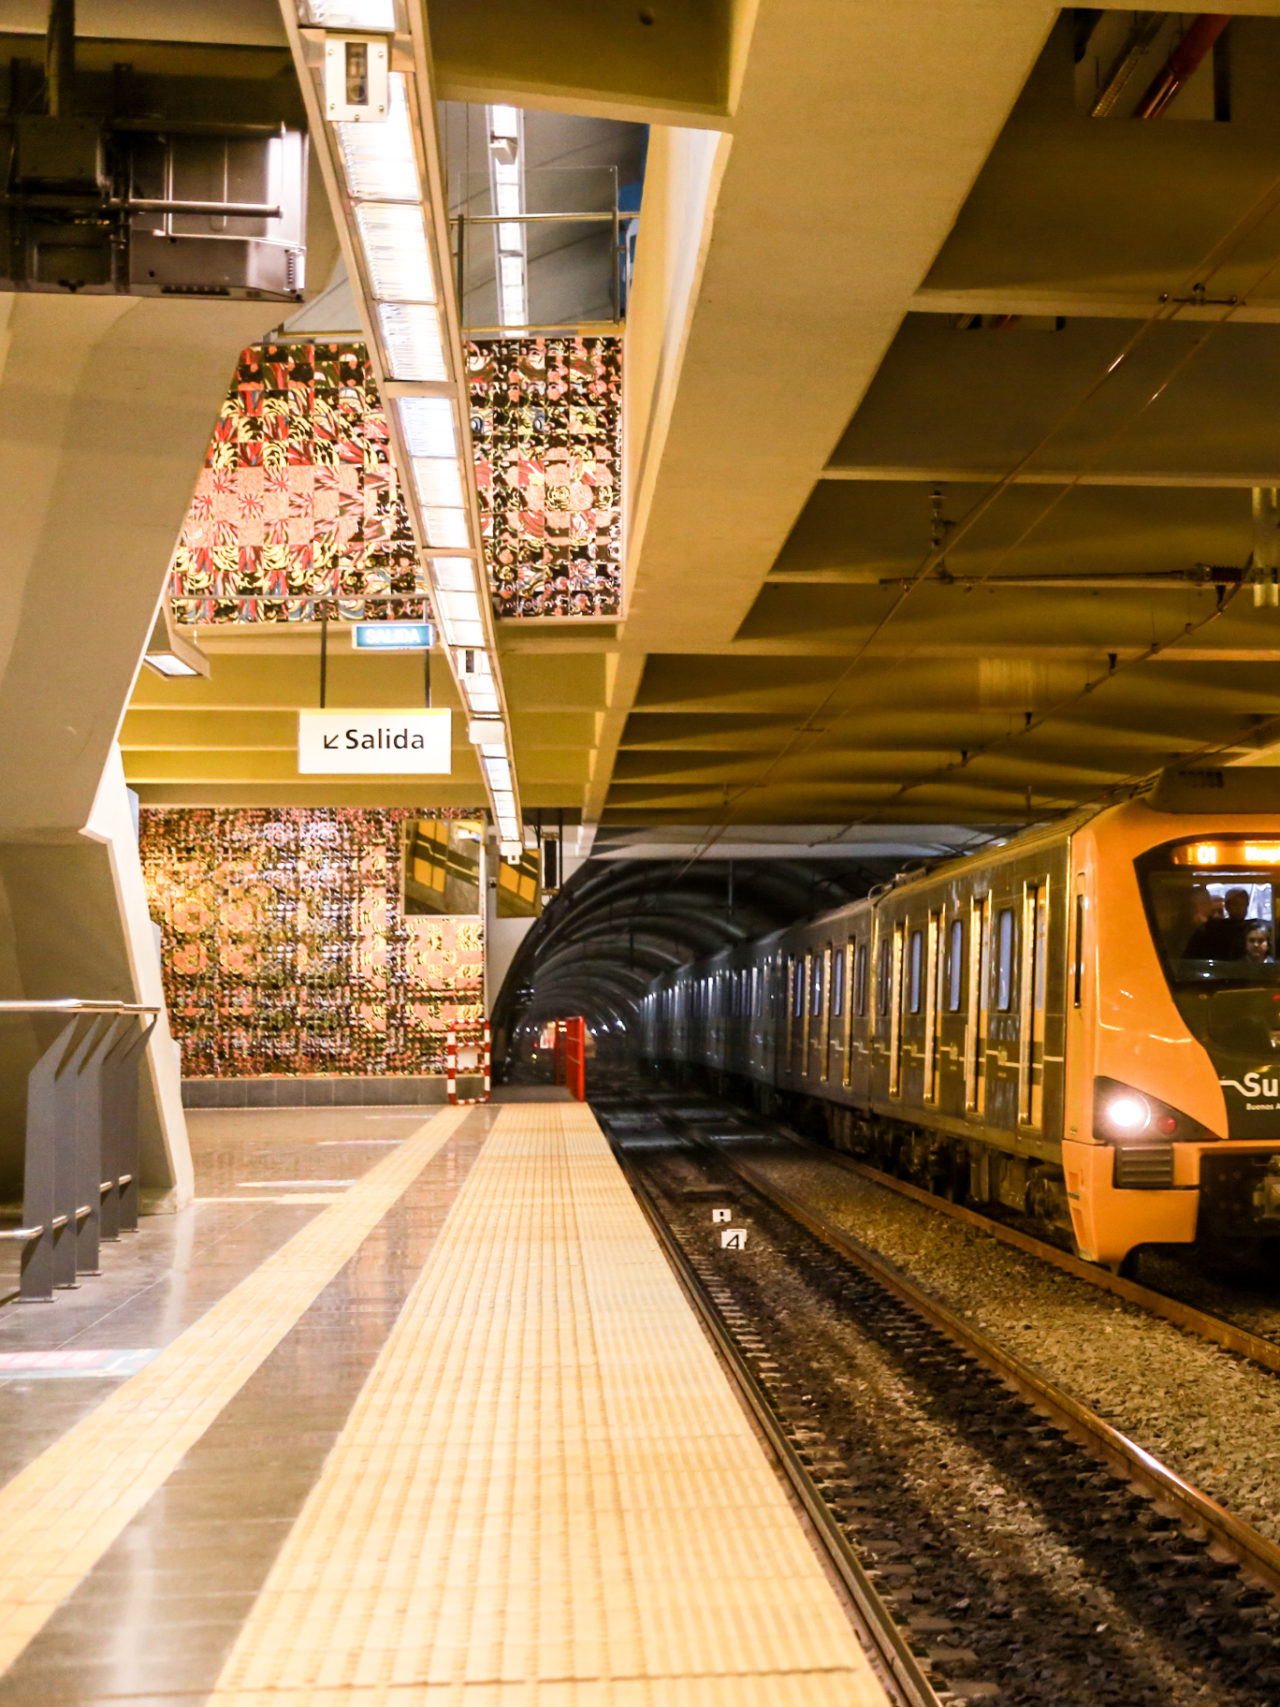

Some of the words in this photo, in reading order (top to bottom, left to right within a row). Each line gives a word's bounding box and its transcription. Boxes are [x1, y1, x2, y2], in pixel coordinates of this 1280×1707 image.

[365, 628, 421, 644] SALIDA
[345, 728, 424, 749] Salida
[1246, 1102, 1274, 1111] Buenos
